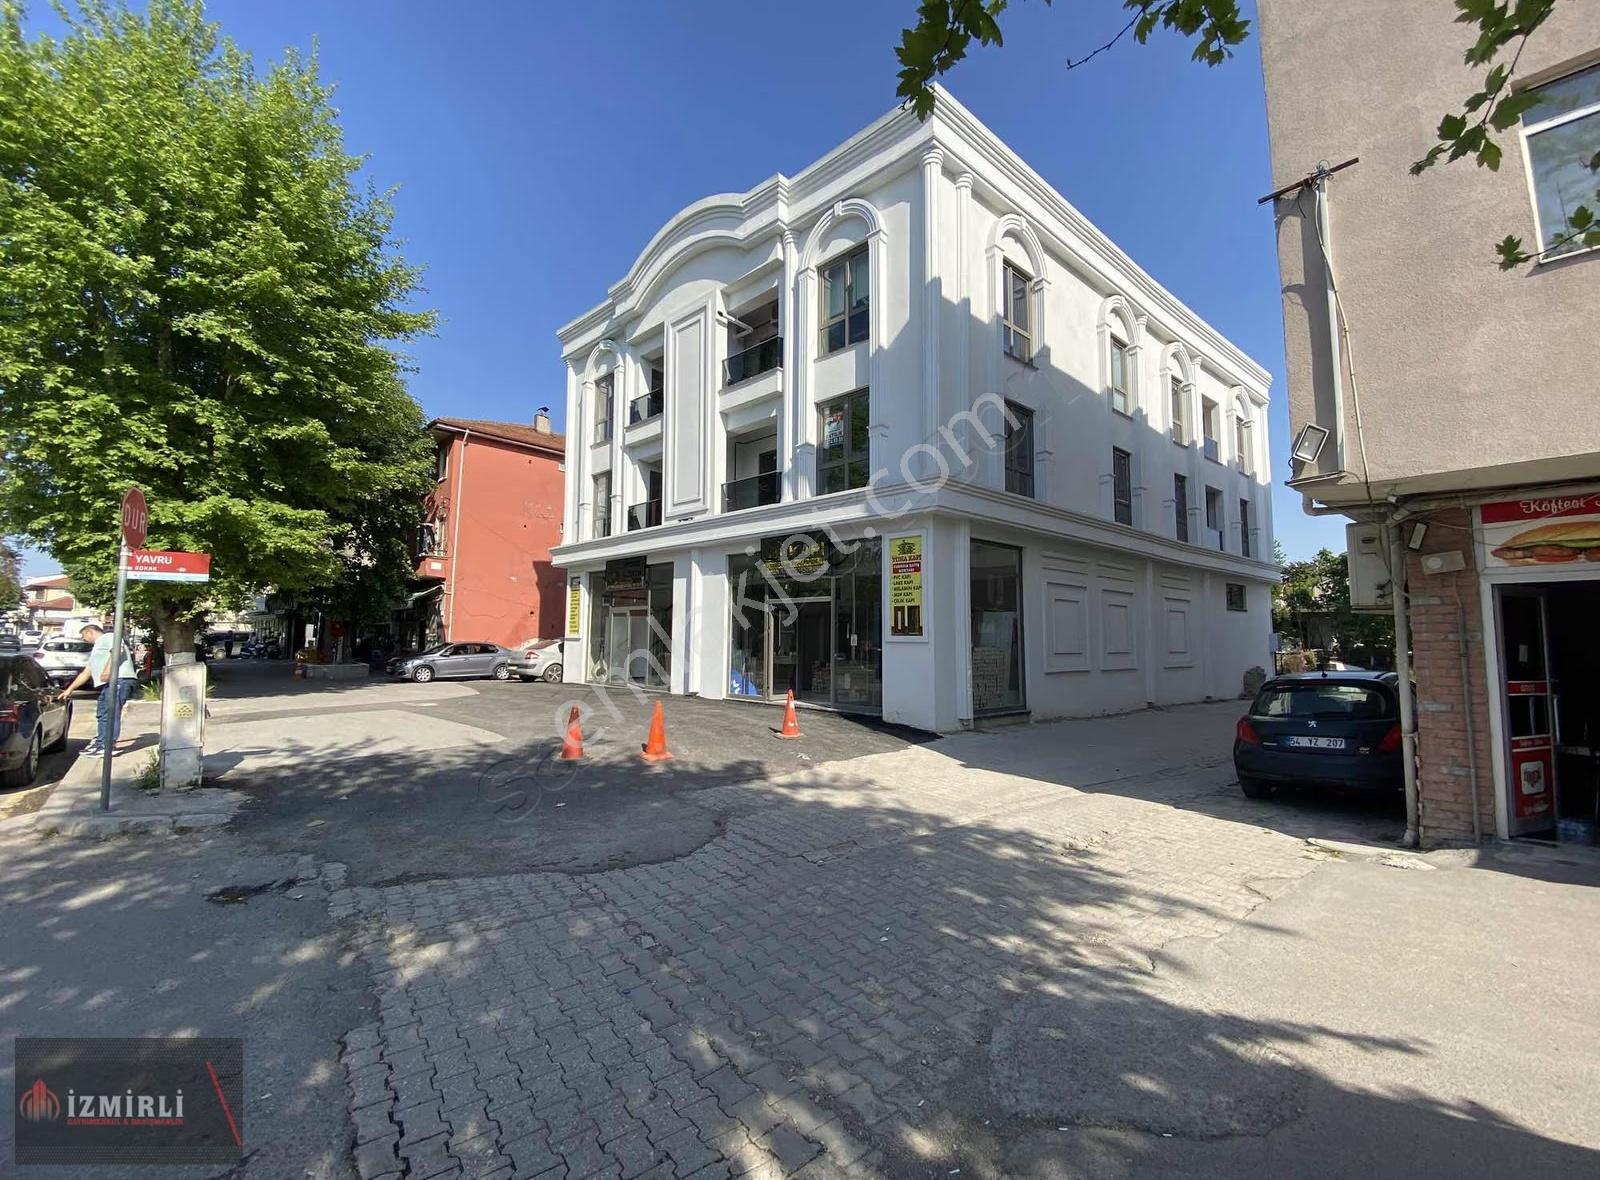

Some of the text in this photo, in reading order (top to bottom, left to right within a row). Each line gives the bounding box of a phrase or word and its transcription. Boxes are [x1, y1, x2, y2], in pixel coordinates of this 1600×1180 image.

[124, 504, 146, 534] DUR
[135, 554, 172, 565] YAVRU
[1290, 737, 1344, 748] 54 YZ 207
